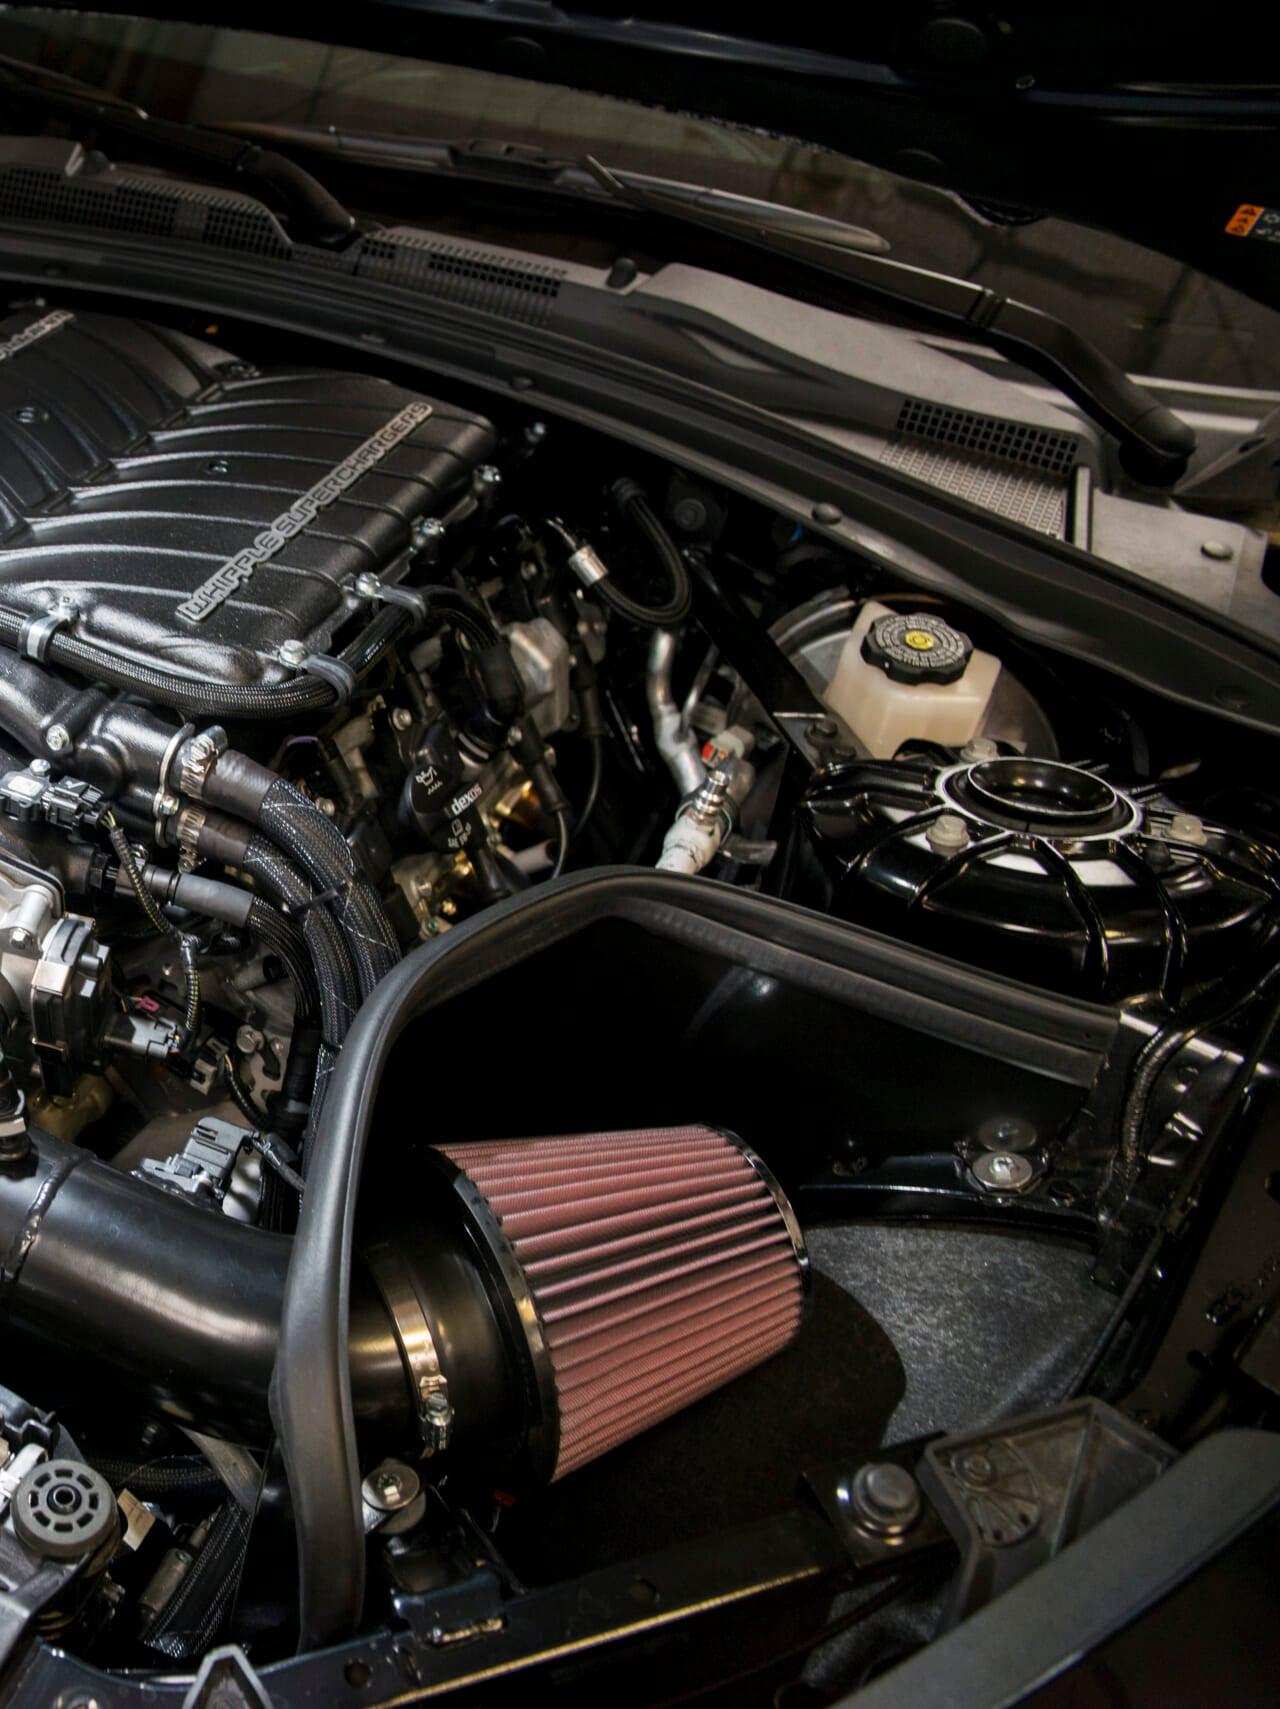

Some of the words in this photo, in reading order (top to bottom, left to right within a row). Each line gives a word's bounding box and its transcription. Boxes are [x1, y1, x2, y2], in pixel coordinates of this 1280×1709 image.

[181, 533, 283, 617] WHIPPLE
[275, 402, 430, 536] SUPERCHARGERS
[451, 784, 482, 815] dexos
